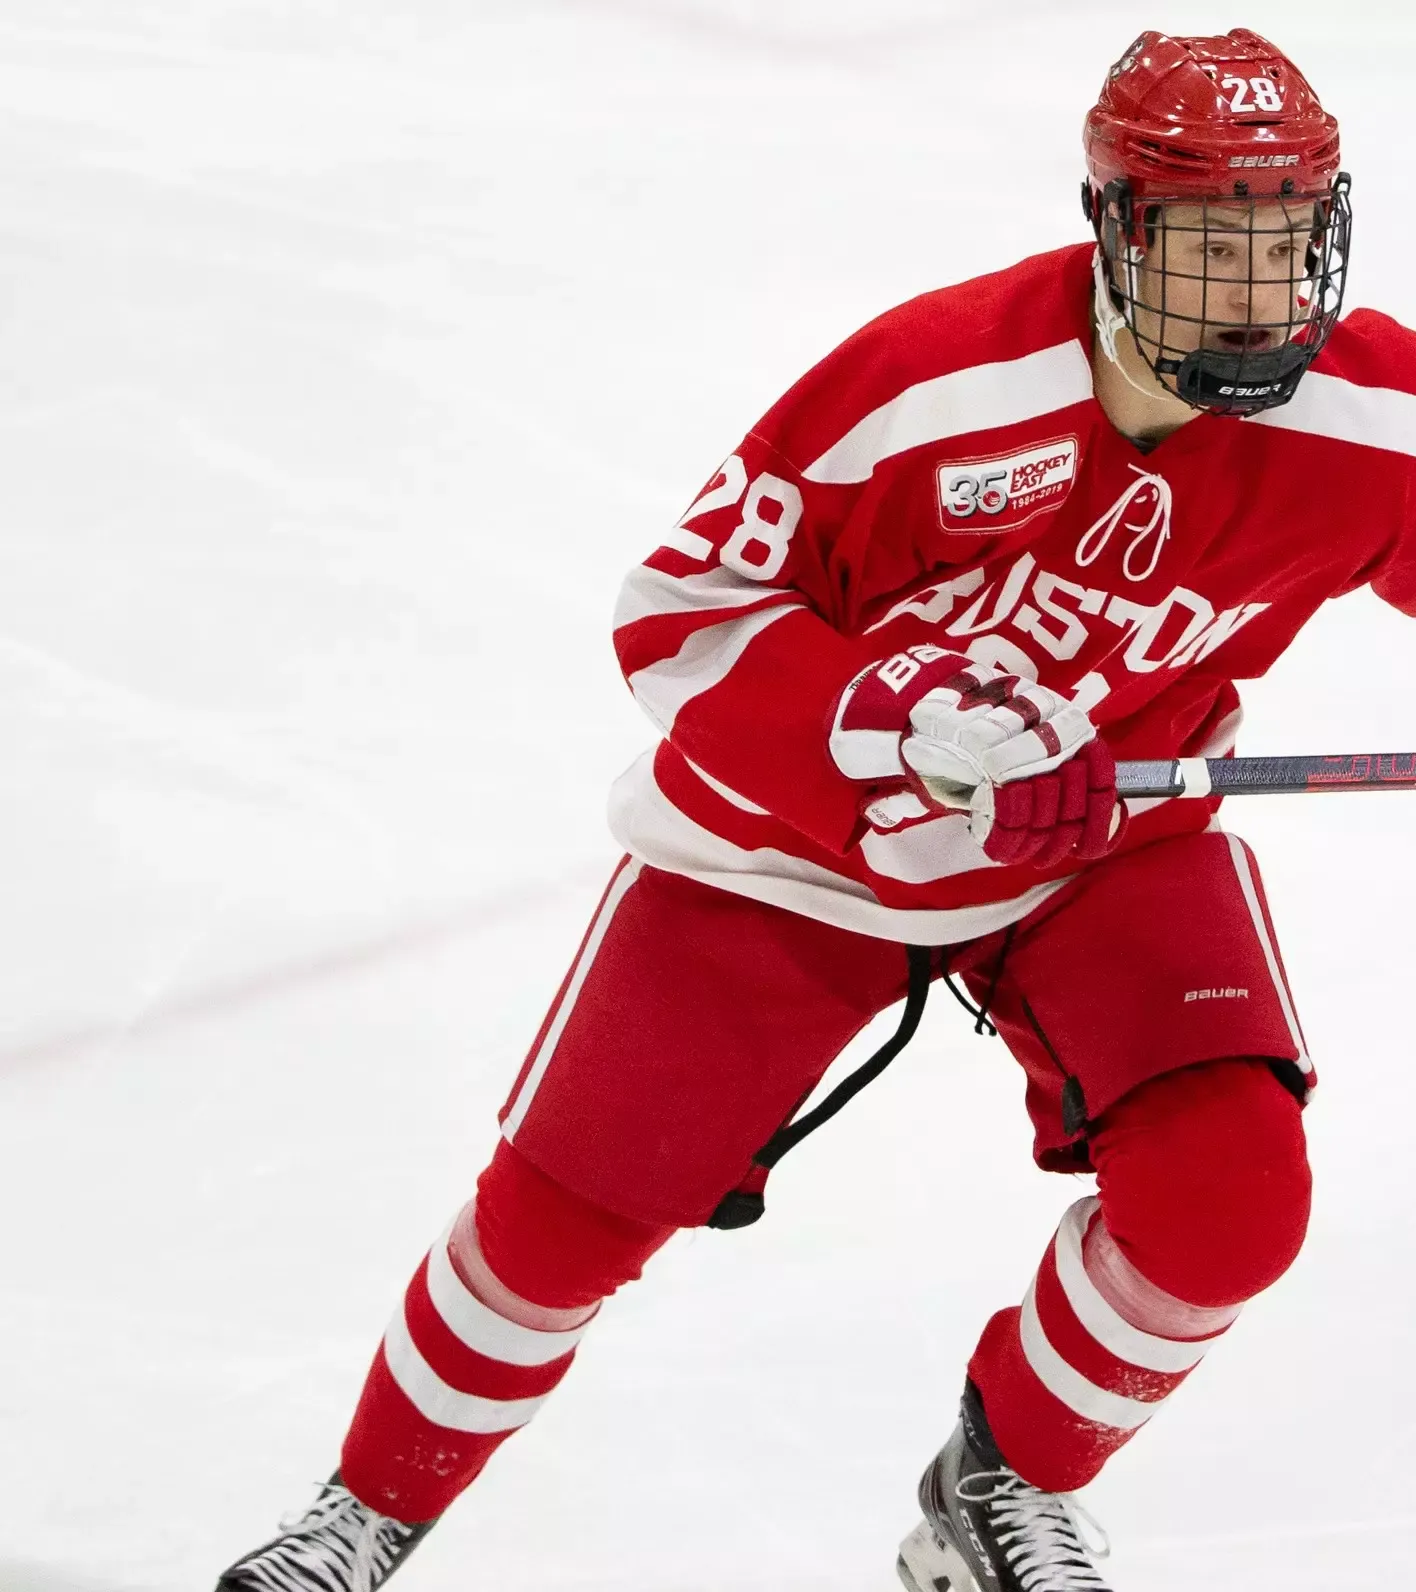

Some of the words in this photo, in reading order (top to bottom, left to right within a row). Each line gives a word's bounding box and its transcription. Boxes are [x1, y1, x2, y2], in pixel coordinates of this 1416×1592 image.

[1221, 77, 1284, 112] 28
[1228, 155, 1299, 168] BAUER
[1010, 471, 1047, 493] EAST
[1011, 453, 1072, 480] HOCKEY
[946, 470, 1008, 517] 35
[661, 453, 804, 581] 28
[1184, 987, 1248, 1002] BAUER
[959, 1508, 996, 1577] CCM
